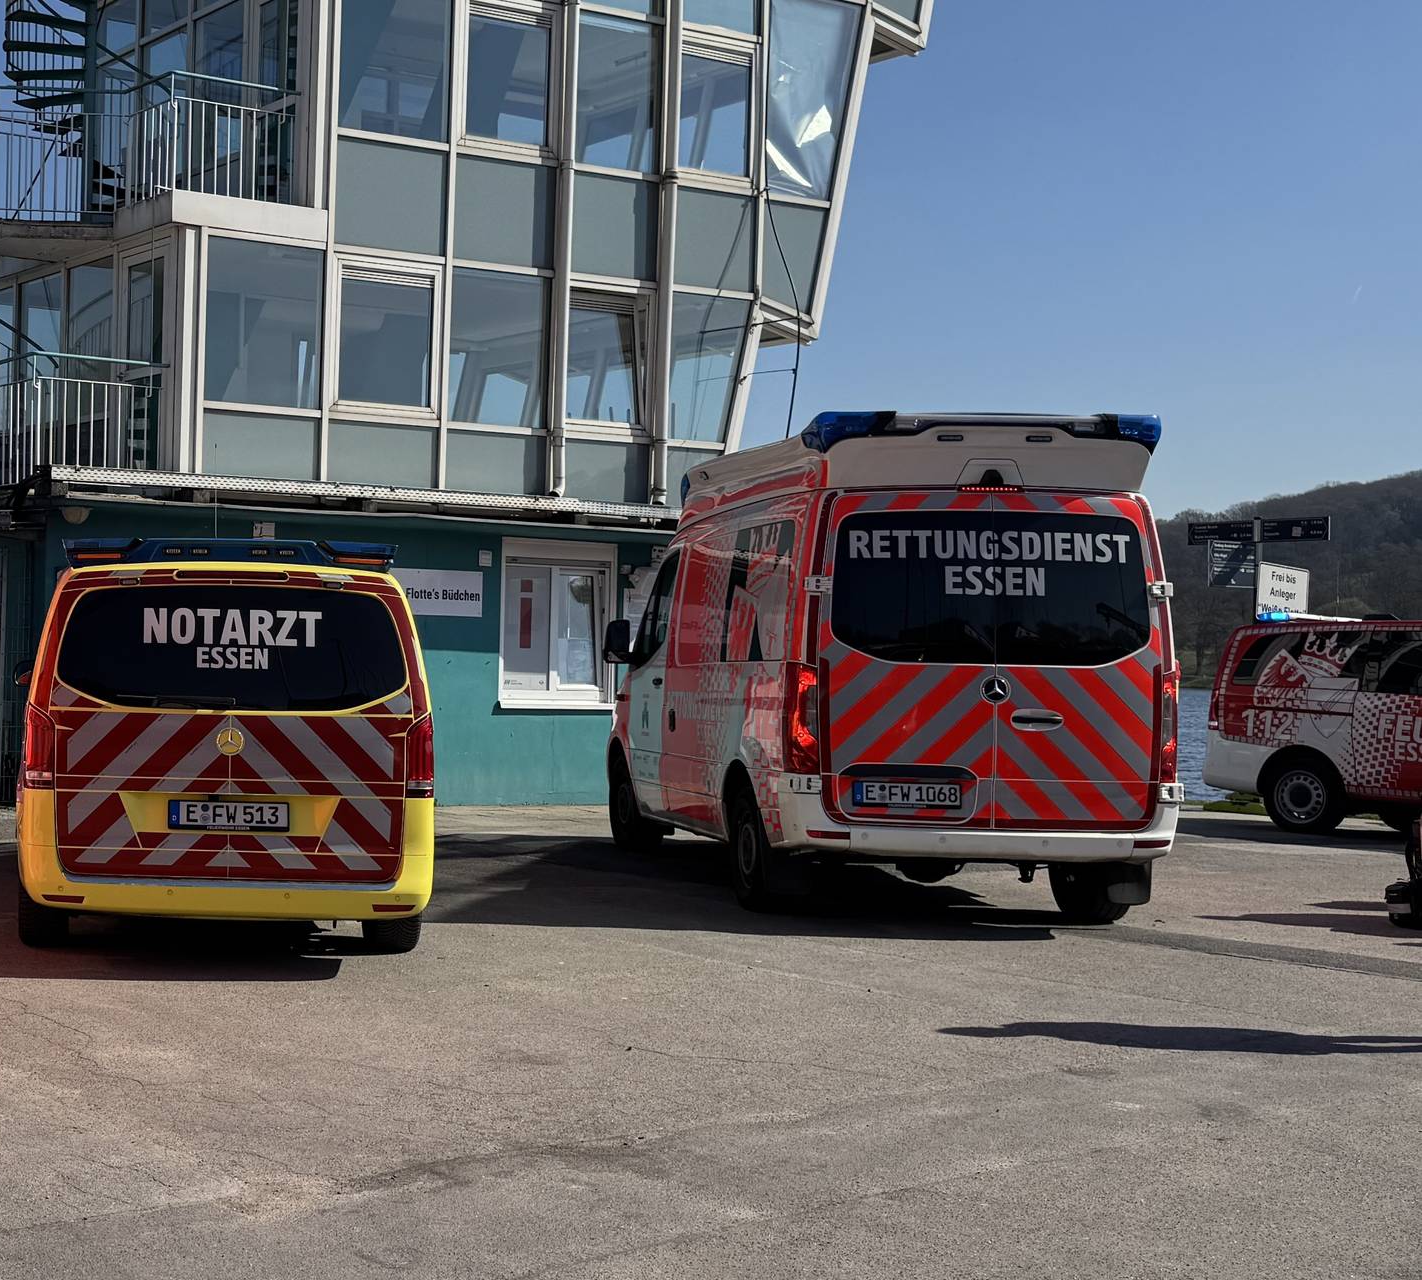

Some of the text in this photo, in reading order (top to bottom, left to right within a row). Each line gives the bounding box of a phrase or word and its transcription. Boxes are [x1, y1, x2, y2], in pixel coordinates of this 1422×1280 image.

[849, 530, 1131, 564] RETTUNGSDIENST
[944, 565, 1046, 597] ESSEN
[1271, 571, 1297, 584] Frei bis
[406, 587, 481, 602] Flotte's Büdchen
[1269, 587, 1296, 601] Anleger
[143, 607, 323, 647] NOTARZT
[196, 646, 269, 669] ESSEN
[1241, 708, 1295, 741] 112
[865, 784, 877, 800] E
[888, 785, 911, 802] FW
[915, 786, 958, 803] 1068
[186, 803, 198, 823] E
[212, 804, 238, 824] FW
[242, 805, 279, 825] 513
